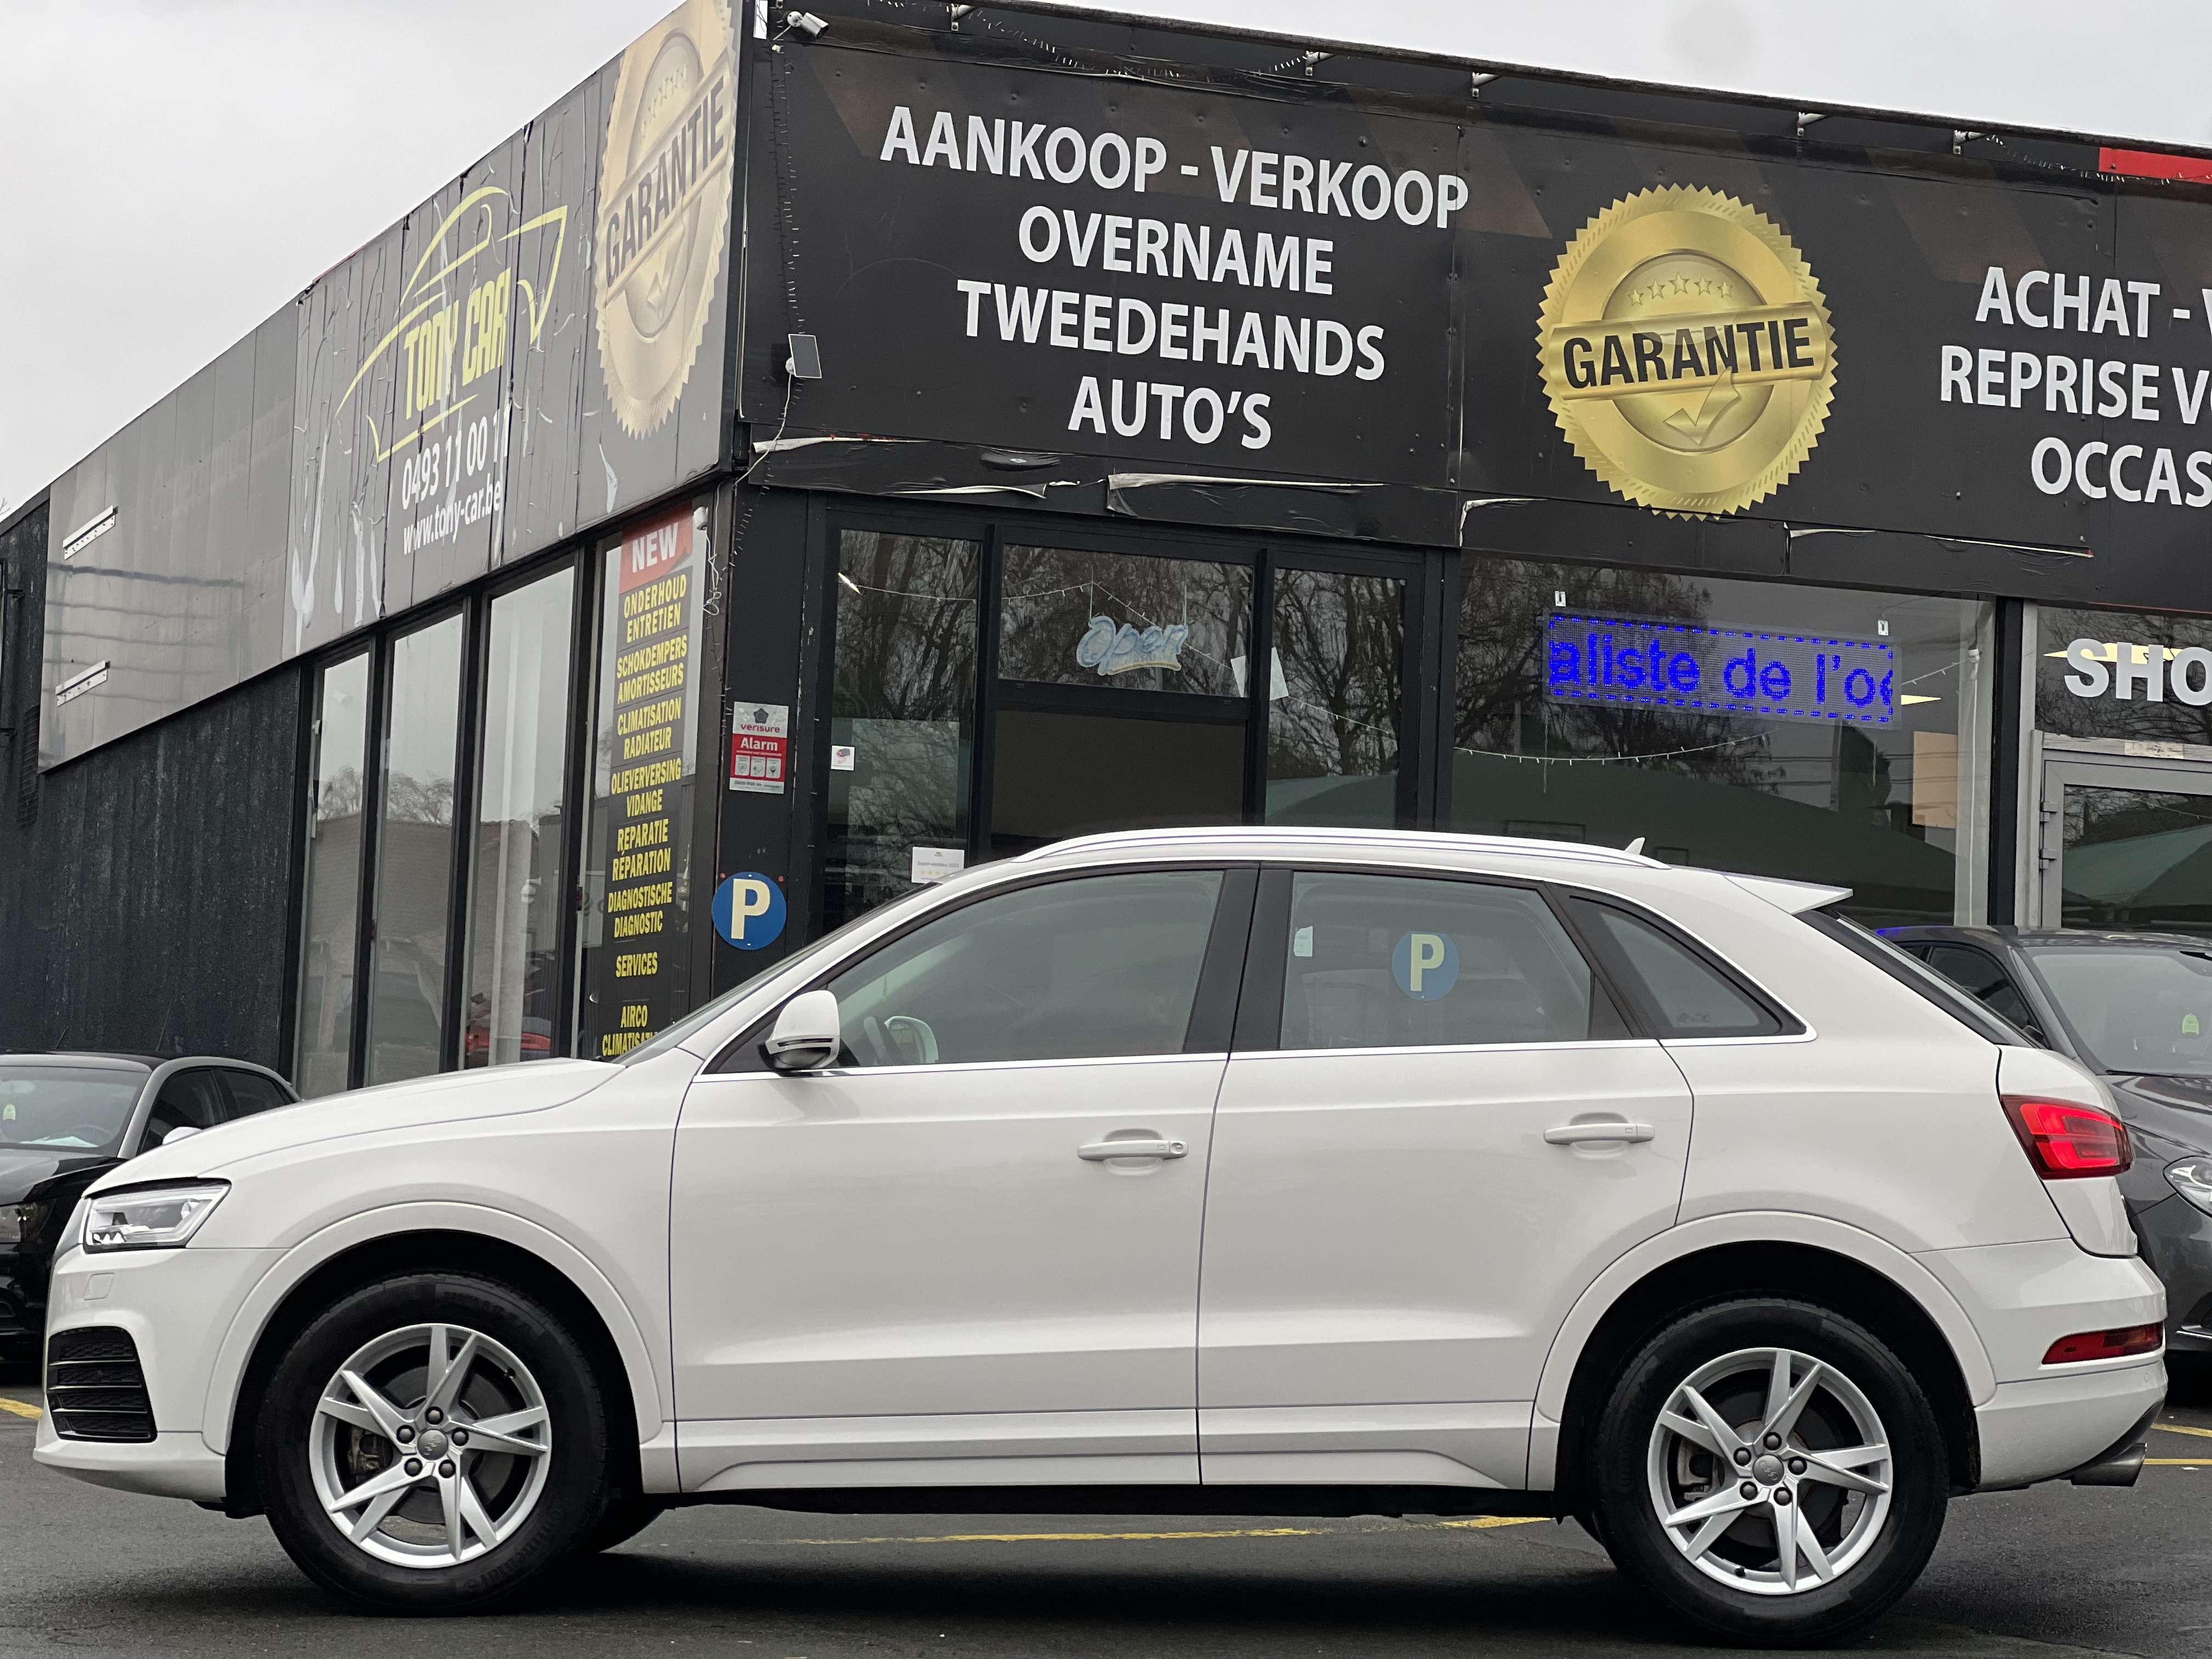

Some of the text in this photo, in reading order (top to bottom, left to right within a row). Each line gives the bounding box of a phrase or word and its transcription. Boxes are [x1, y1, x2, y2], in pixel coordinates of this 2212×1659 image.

[606, 75, 725, 288] GARANTIE
[879, 105, 1469, 229] AANKOOP - VERKOOP
[1019, 205, 1334, 295] OVERNAME
[462, 267, 511, 387] CAR
[1975, 266, 2160, 338] ACHAT
[2173, 308, 2191, 319] -
[956, 279, 1385, 381] TWEEDEHANDS
[1562, 317, 1815, 389] GARANTIE
[1940, 345, 2212, 425] REPRISE V
[1067, 376, 1272, 449] AUTO'S
[402, 442, 439, 510] 0493
[445, 430, 462, 488] 11
[466, 416, 488, 476] 00
[2031, 437, 2212, 507] OCCAS
[403, 472, 501, 555] www.tony-car.be
[632, 522, 679, 573] NEW
[623, 574, 687, 619] ONDERHOUD
[626, 602, 681, 644] ENTRETIEN
[1078, 617, 1187, 675] Open
[617, 634, 687, 679] SCHOKDEMPERS
[1723, 647, 1791, 701] de
[2064, 638, 2212, 706] SHO
[617, 662, 684, 704] AMORTISSEURS
[617, 696, 681, 736] CLIMATISATION
[741, 724, 781, 733] verisure
[623, 726, 672, 760] RADIATEUR
[740, 737, 778, 751] Alarm
[611, 758, 681, 795] OLIEVERVERSING
[626, 788, 663, 817] VIDANGE
[617, 818, 669, 852] REPARATIE
[608, 881, 673, 913] DIAGNOSTISCHE
[731, 878, 771, 940] P
[613, 910, 663, 938] DIAGNOSTIC
[615, 951, 658, 978] SERVICES
[620, 1005, 648, 1028] AIRCO
